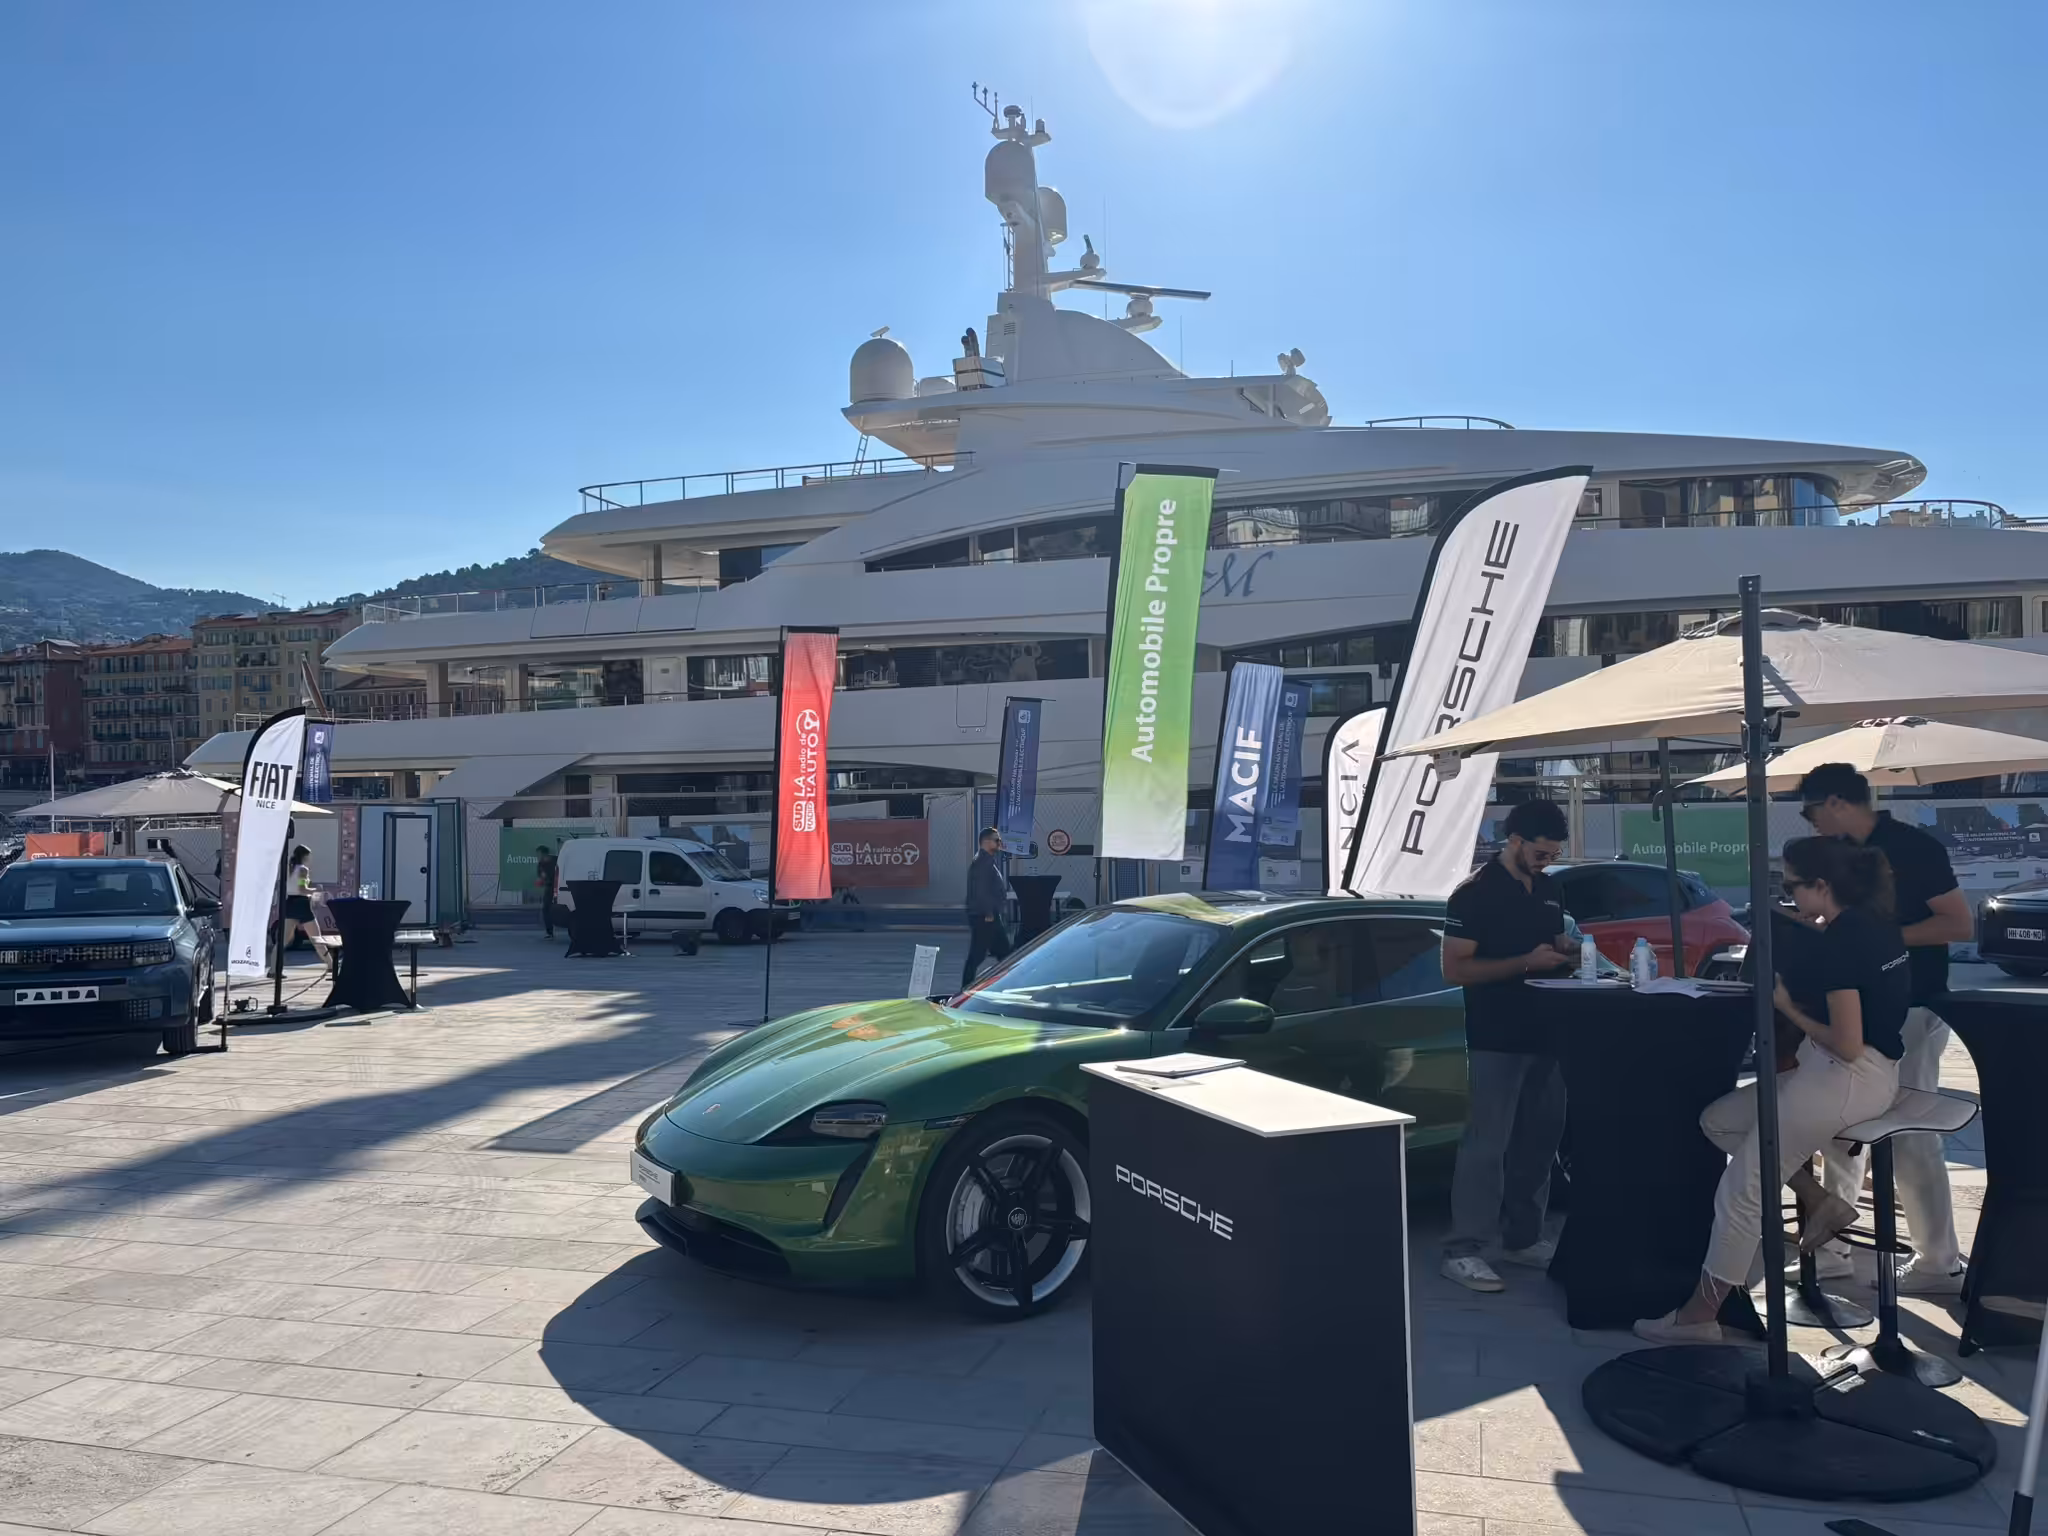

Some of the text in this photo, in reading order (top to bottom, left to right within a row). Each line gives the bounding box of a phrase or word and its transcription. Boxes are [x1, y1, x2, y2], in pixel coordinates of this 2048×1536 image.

[1131, 498, 1178, 764] Automobile Propre
[794, 732, 807, 797] LA radio de
[249, 760, 293, 801] FIAT
[1224, 726, 1262, 843] MACIF
[256, 799, 276, 810] NICE
[794, 803, 803, 829] SUD
[832, 844, 852, 853] SUD
[855, 842, 872, 854] LA
[872, 845, 892, 853] radio
[855, 853, 903, 865] L'AUTO
[1, 950, 18, 964] FIAT
[16, 989, 97, 1002] PANDA
[1116, 1164, 1234, 1241] PORSCHE
